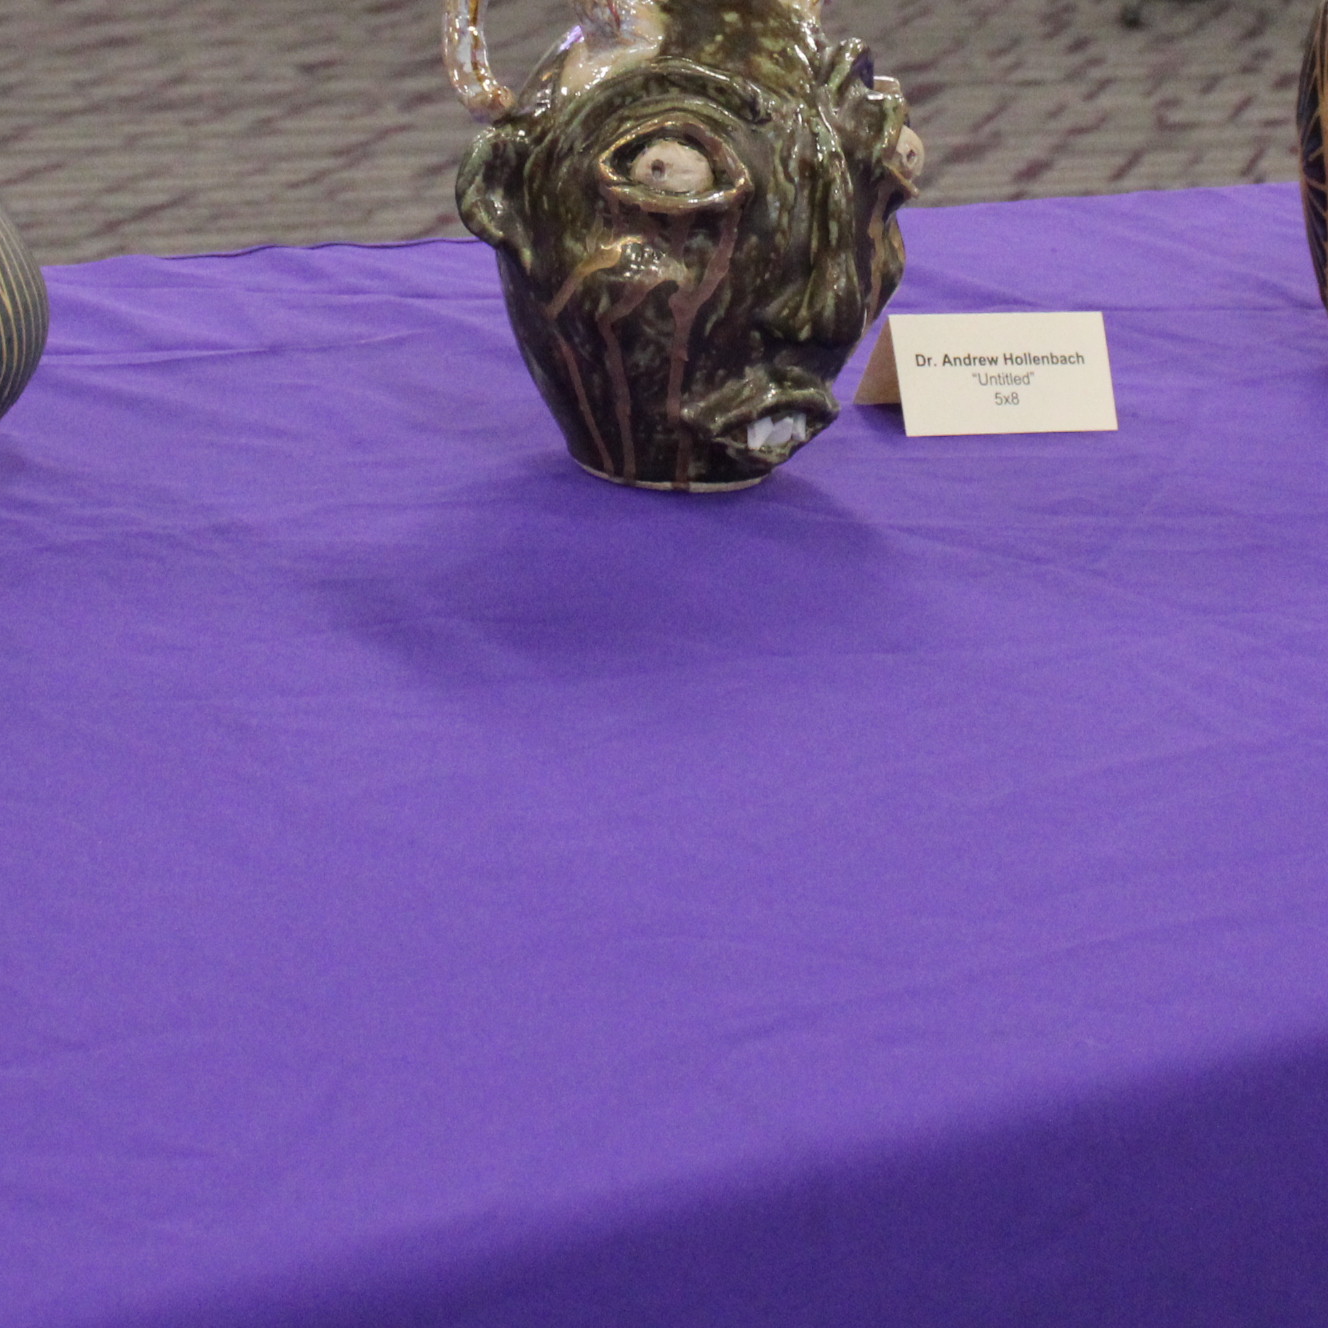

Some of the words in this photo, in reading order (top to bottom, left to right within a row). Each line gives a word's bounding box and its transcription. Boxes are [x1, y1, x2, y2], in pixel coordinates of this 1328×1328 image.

[915, 354, 937, 367] Dr.
[942, 354, 999, 366] Andrew
[1003, 352, 1085, 366] Hollenbach
[972, 372, 1035, 386] "Untitled"
[994, 392, 1020, 406] 5x8
